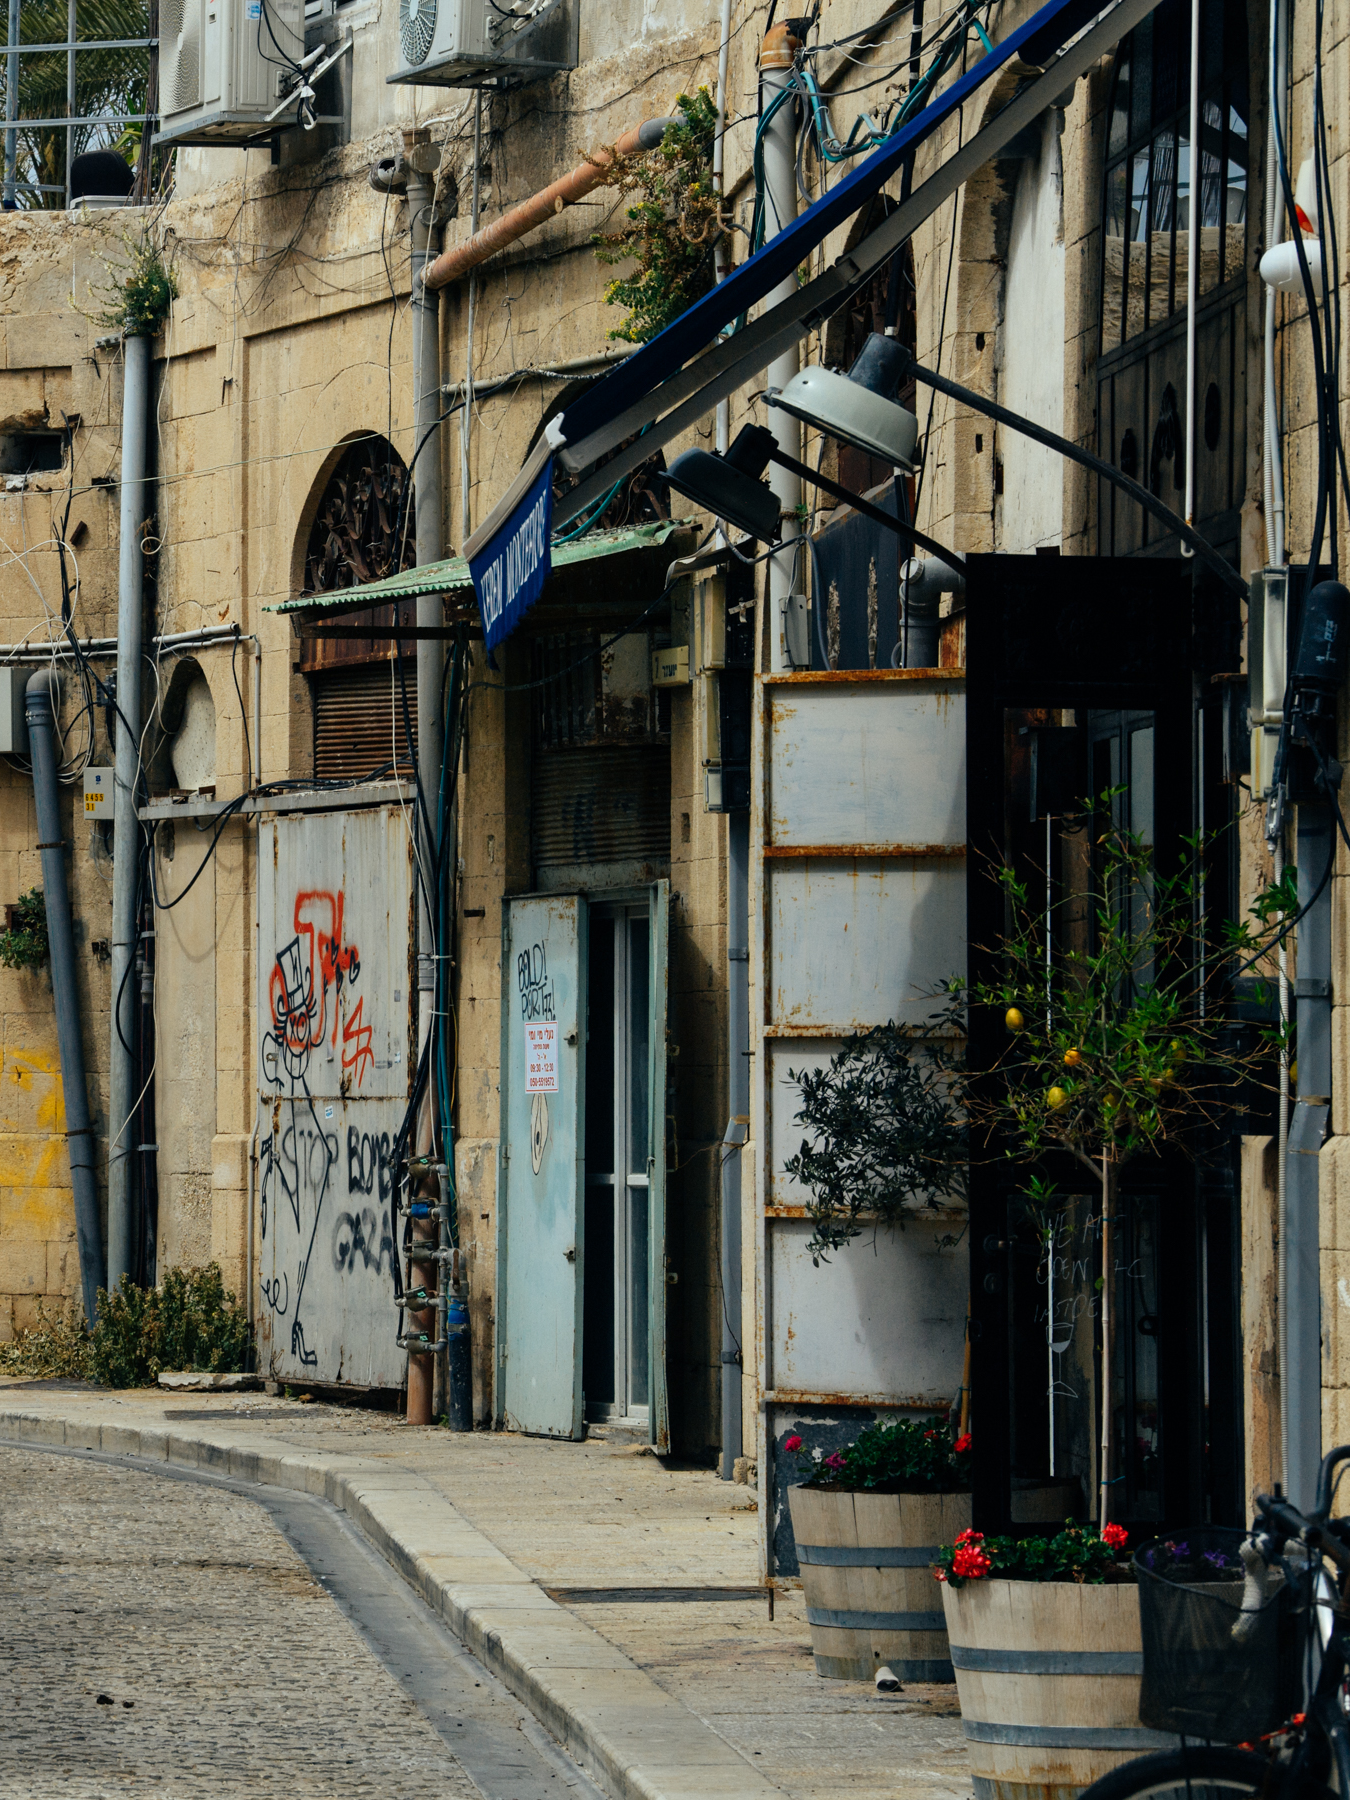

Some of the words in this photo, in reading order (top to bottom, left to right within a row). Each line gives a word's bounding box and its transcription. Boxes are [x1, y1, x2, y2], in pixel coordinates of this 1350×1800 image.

[86, 802, 95, 811] 31
[281, 1124, 339, 1197] STOP
[331, 1207, 397, 1283] GAZA
